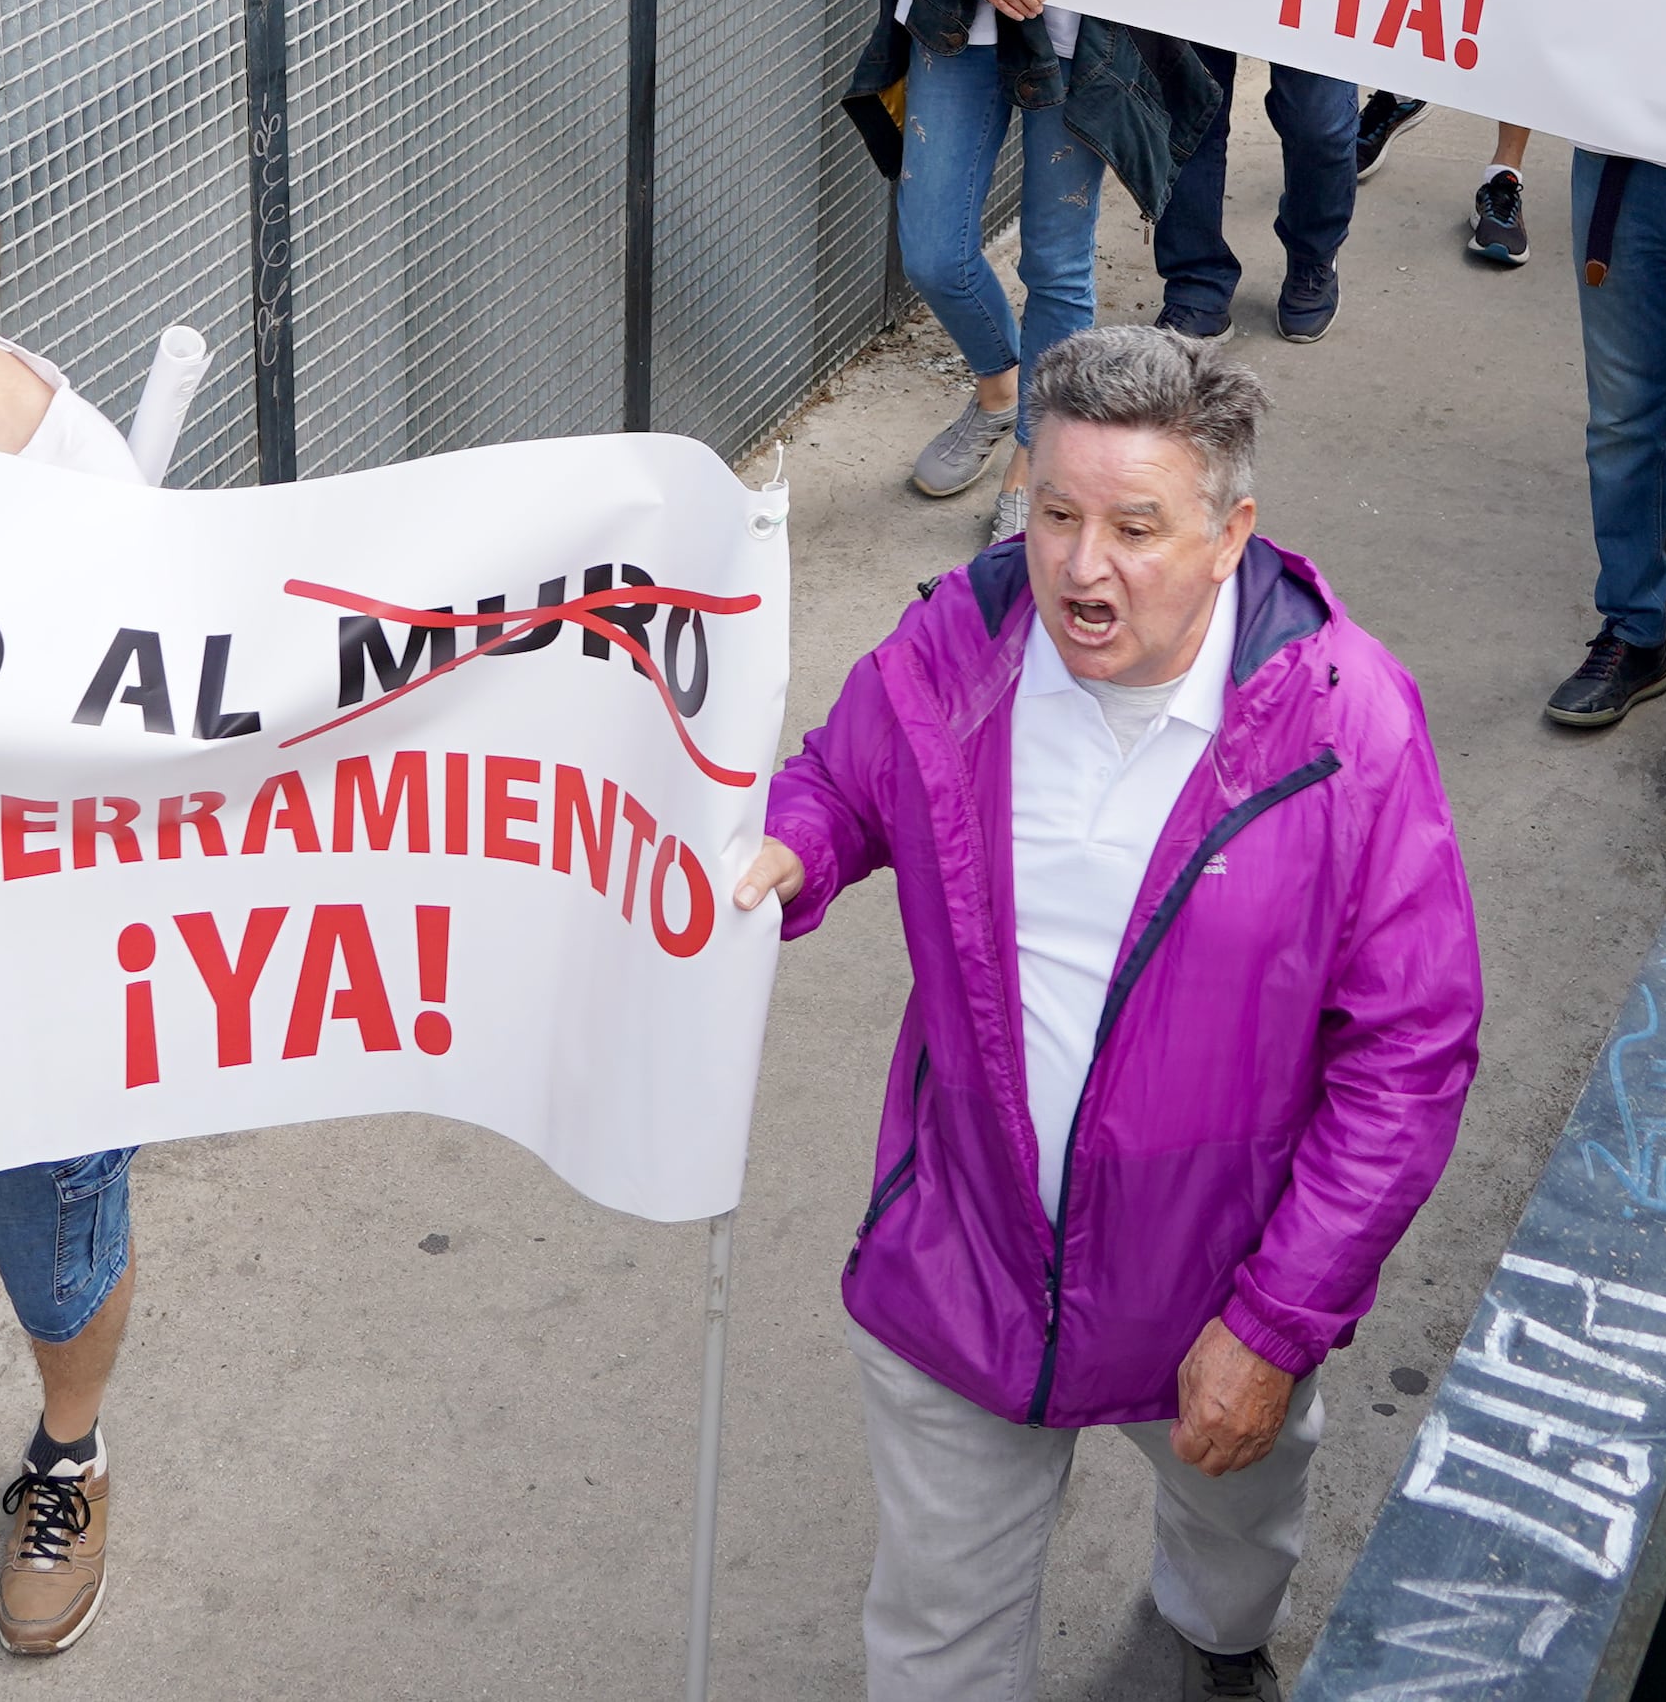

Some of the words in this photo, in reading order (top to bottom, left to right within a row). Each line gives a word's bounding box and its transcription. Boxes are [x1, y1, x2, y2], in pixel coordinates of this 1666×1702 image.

[71, 626, 262, 741] AL
[336, 561, 711, 719] MURO
[114, 902, 455, 1090] ¡YA!
